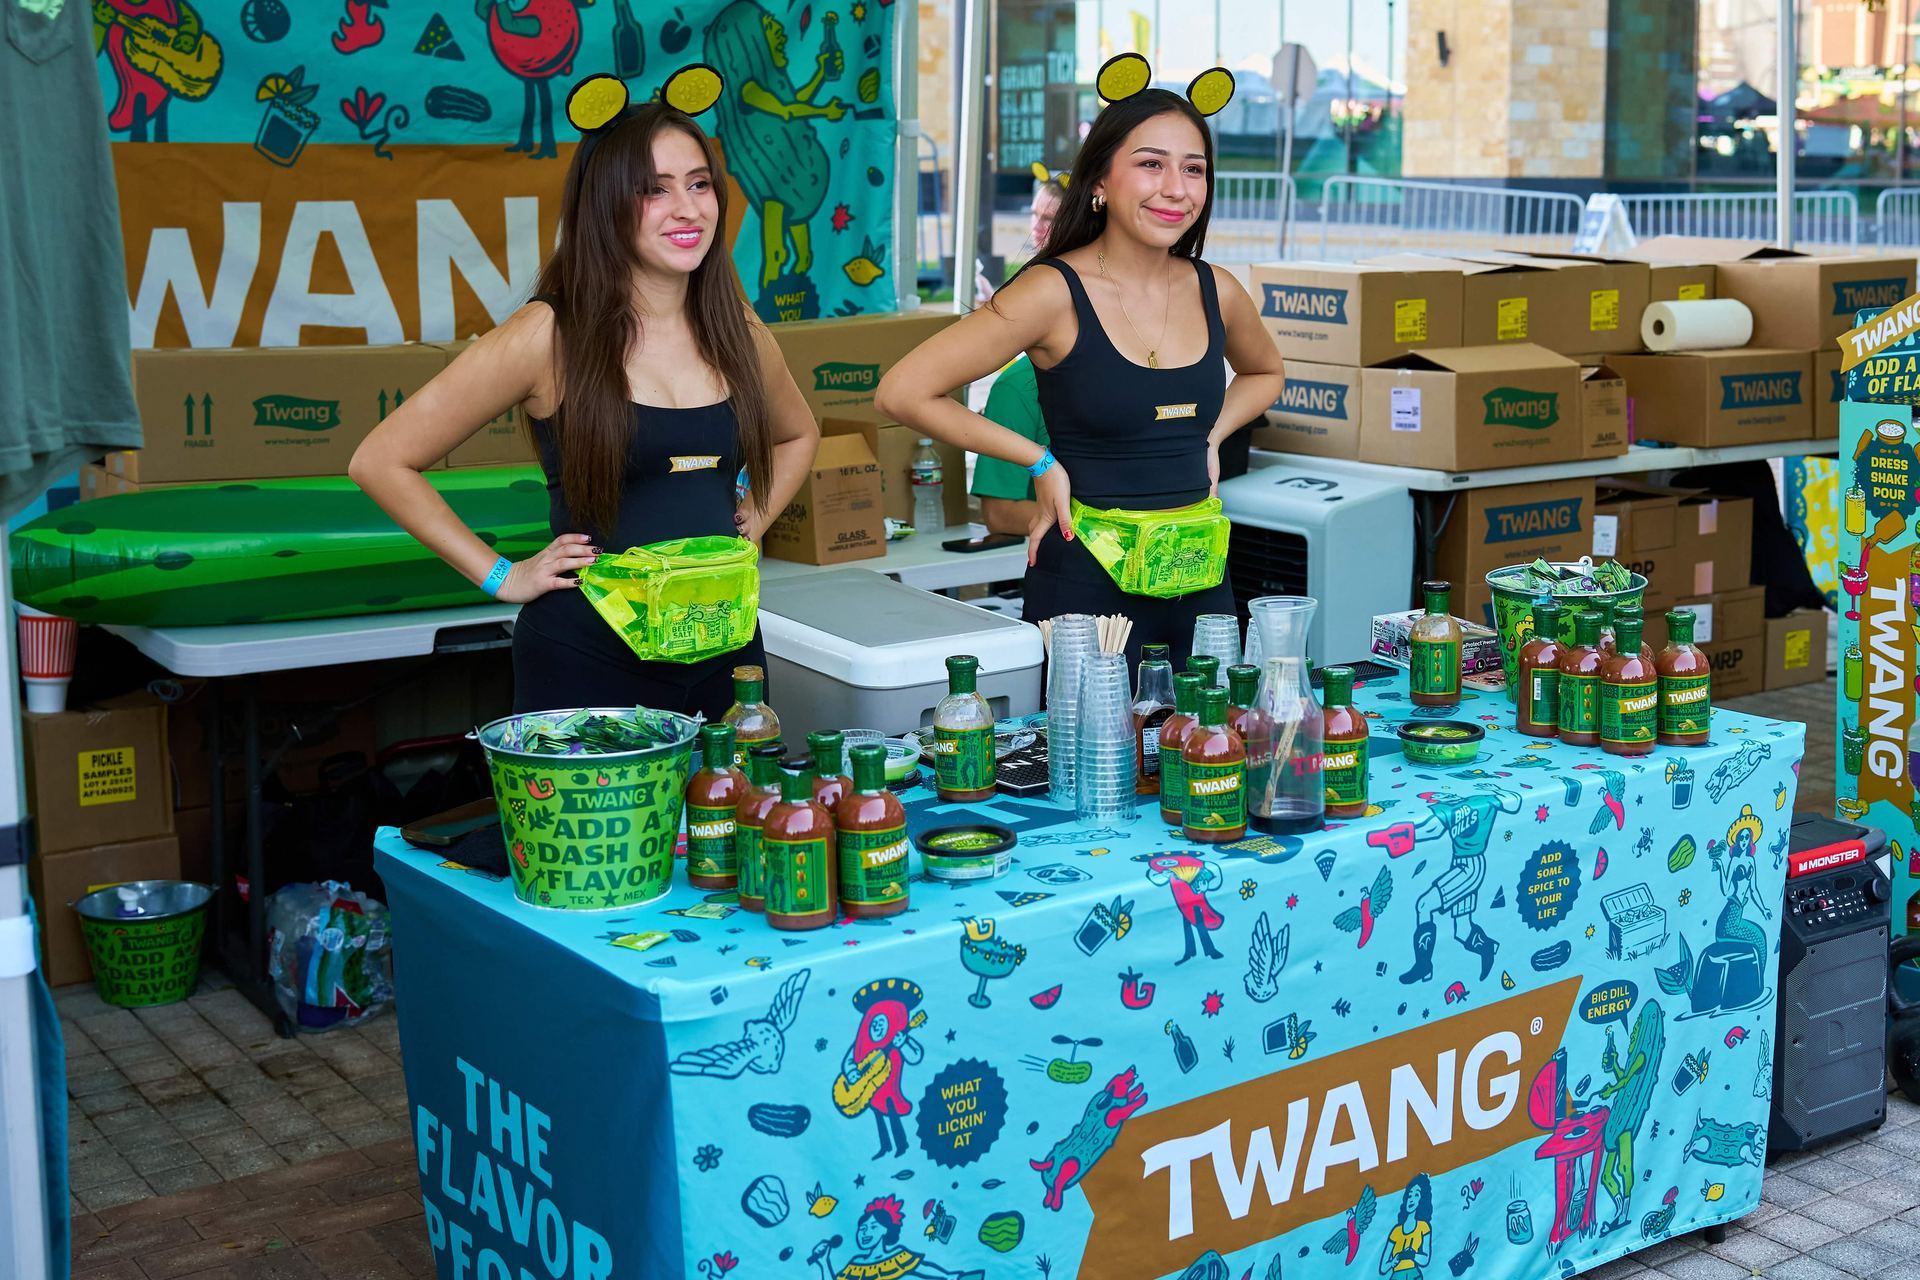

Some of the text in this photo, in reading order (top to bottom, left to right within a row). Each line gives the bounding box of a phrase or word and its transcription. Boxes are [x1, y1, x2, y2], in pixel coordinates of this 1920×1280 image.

[129, 196, 541, 348] WAN
[775, 291, 807, 306] WHAT
[1272, 290, 1337, 317] TWANG
[1843, 285, 1899, 307] TWANG
[780, 308, 802, 322] YOU
[820, 366, 874, 387] Twang
[1863, 357, 1917, 377] ADD A
[1732, 375, 1793, 401] TWANG
[1868, 377, 1890, 395] OF
[1275, 385, 1337, 412] WANG
[262, 402, 331, 424] Twang
[1161, 407, 1192, 417] TWANG
[1492, 397, 1551, 421] Twang
[677, 458, 714, 469] TWANG
[1871, 456, 1909, 471] DRESS
[1870, 471, 1909, 486] SHAKE
[1873, 486, 1906, 501] POUR
[1498, 506, 1572, 537] TWANG
[838, 529, 868, 541] GLASS
[672, 624, 693, 632] BEER
[1710, 650, 1744, 671] MRP
[1868, 577, 1906, 780] TWANG
[1669, 687, 1707, 703] TWANG
[92, 751, 123, 768] PICKLE
[1319, 754, 1354, 769] WANG
[83, 767, 133, 780] SAMPLES
[1190, 766, 1240, 779] PICKLE
[1193, 776, 1238, 794] TWANG
[572, 787, 648, 810] TWANG
[552, 810, 661, 839] ADD A
[1451, 810, 1478, 839] DILLS
[1455, 805, 1471, 825] BIG
[690, 821, 734, 837] TWANG
[537, 831, 671, 866] DASH OF
[1541, 851, 1562, 864] ADD
[1808, 850, 1860, 869] MONSTER
[546, 860, 663, 891] FLAVOR
[1536, 864, 1563, 879] SOME
[1528, 877, 1571, 895] SPICE TO
[569, 889, 648, 905] TEX MEX
[1535, 892, 1563, 906] YOUR
[1538, 906, 1558, 920] LIFE
[127, 934, 176, 950] TWANG
[118, 952, 165, 966] ADD
[109, 966, 165, 980] DASH
[111, 975, 189, 996] FLAVOR
[1591, 985, 1631, 1005] BIG DILL
[1586, 997, 1632, 1020] ENERGY
[941, 1077, 983, 1100] WHAT
[946, 1097, 978, 1116] YOU
[456, 1056, 553, 1189] THE
[937, 1110, 988, 1136] LICKIN'
[953, 1129, 974, 1149] AT
[1140, 1031, 1523, 1241] TWANG
[417, 1104, 613, 1280] FLAVOR
[423, 1195, 537, 1280] PEO
